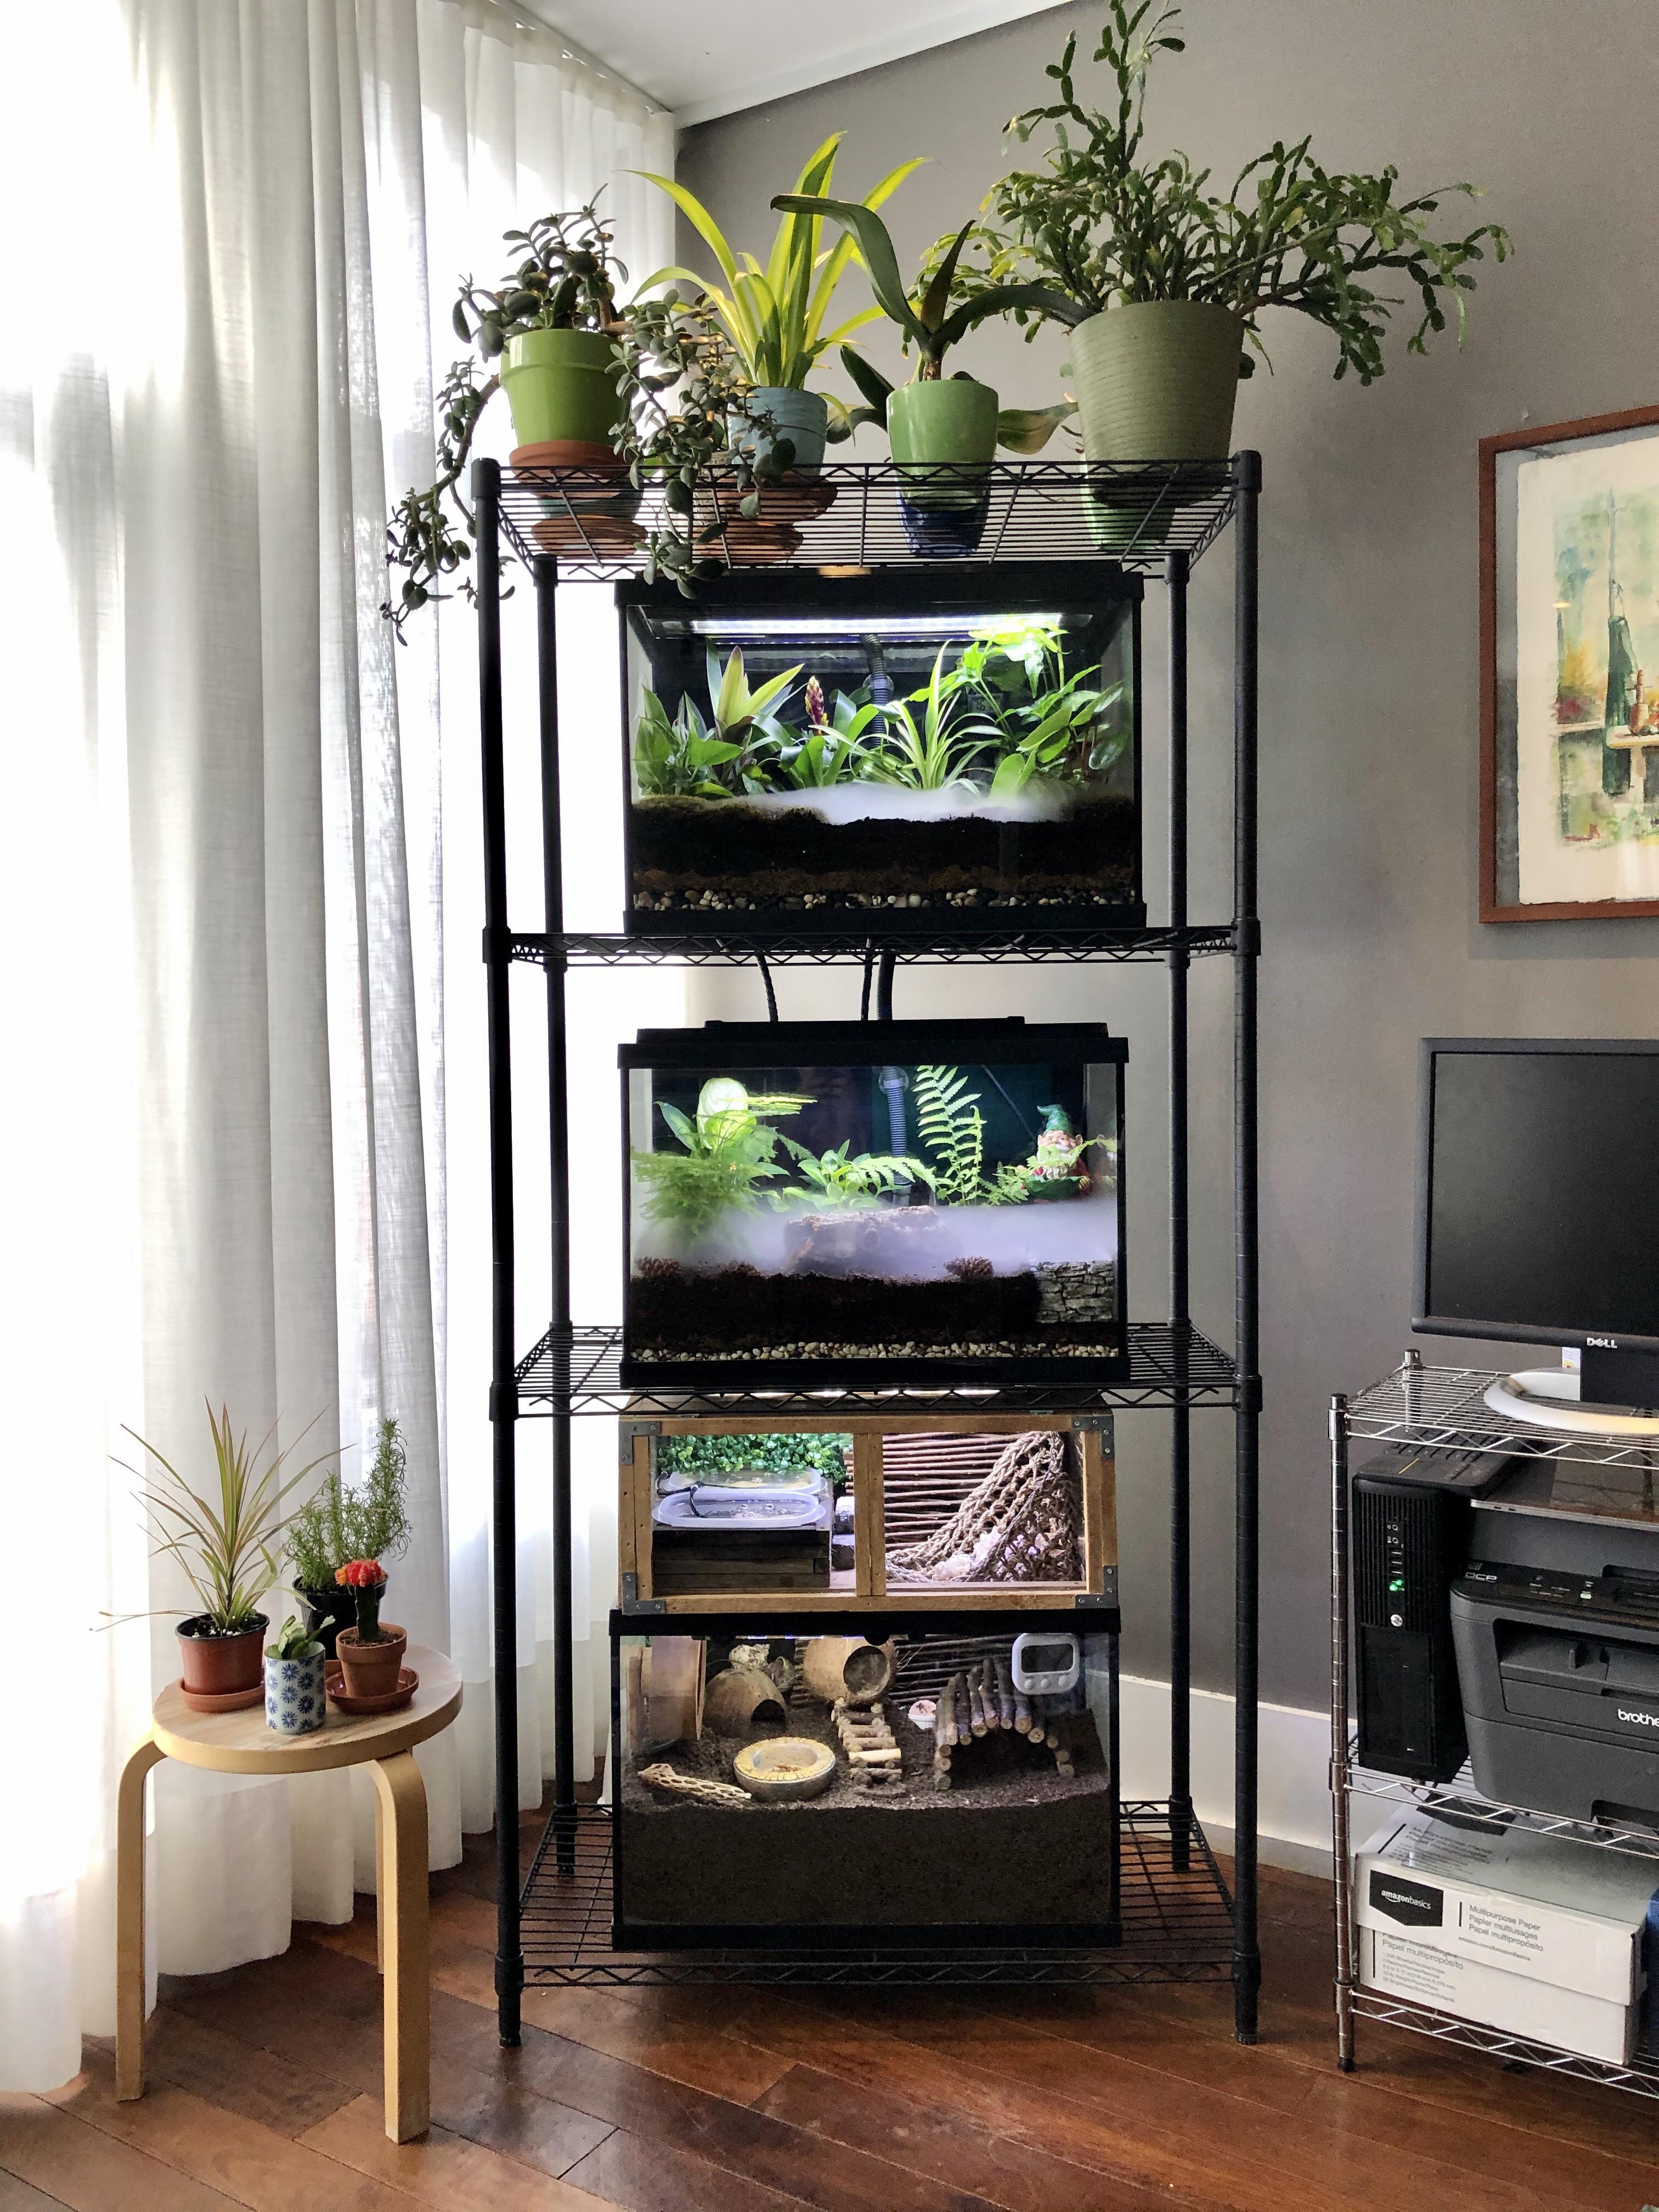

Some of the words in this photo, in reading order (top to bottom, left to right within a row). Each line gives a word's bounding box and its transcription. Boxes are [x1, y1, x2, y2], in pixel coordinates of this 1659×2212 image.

[1587, 1338, 1618, 1348] DELL
[1465, 1572, 1497, 1583] DCP
[1381, 1890, 1431, 1909] amazonbasics
[1469, 1904, 1516, 1924] Multipurpose
[1518, 1918, 1541, 1931] Paper
[1469, 1914, 1492, 1927] Papier
[1494, 1922, 1538, 1940] multiusages
[1469, 1923, 1489, 1934] Papel
[1491, 1931, 1544, 1952] multipropósito
[1383, 1939, 1404, 1951] Papel
[1406, 1947, 1464, 1970] multipropósito
